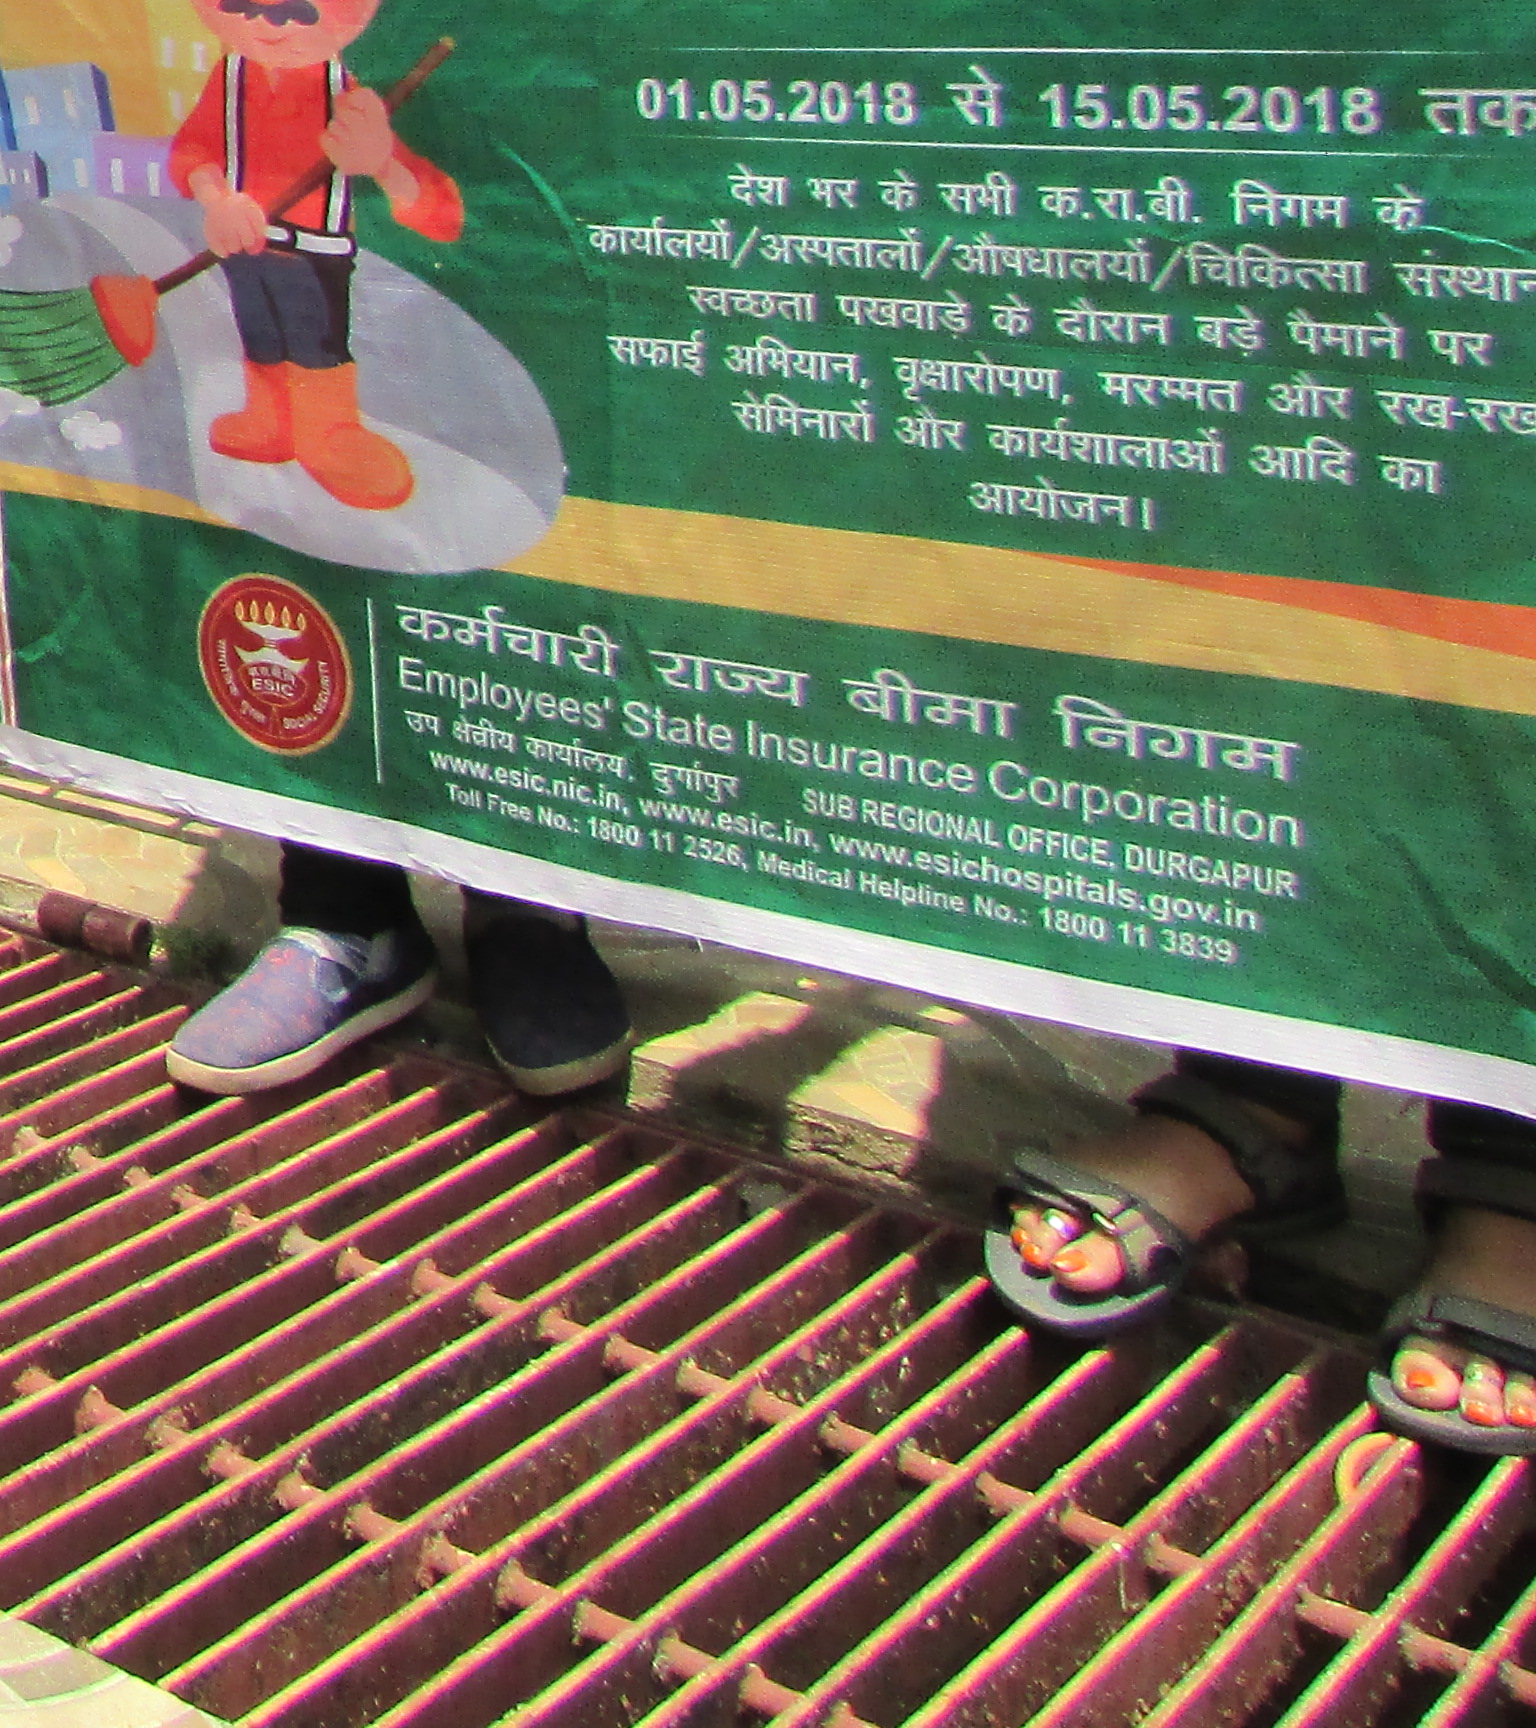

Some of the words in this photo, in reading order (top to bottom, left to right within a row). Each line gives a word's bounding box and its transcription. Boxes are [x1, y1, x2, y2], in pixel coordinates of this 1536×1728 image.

[636, 76, 920, 127] 01.05.2018
[946, 65, 1002, 129] से
[1037, 82, 1383, 137] 15.05.2018
[1418, 88, 1536, 136] तक
[728, 162, 790, 207] देश
[806, 176, 860, 209] भर
[877, 168, 920, 212] के
[936, 171, 1017, 217] सभी
[1038, 175, 1205, 223] क.रा.बी.
[1230, 178, 1350, 229] निगम
[1372, 183, 1427, 232] के
[686, 285, 818, 323] स्वच्छता
[835, 289, 972, 338] पखवाड़े
[990, 293, 1032, 337] के
[1053, 297, 1173, 345] दौरान
[1192, 305, 1264, 358] बड़े
[1285, 308, 1405, 360] पैमाने
[1426, 329, 1494, 366] पर
[606, 329, 706, 377] सफाई
[1097, 372, 1245, 414] मरम्मत
[1265, 372, 1353, 419] और
[1373, 389, 1536, 436] रख-रख
[730, 390, 877, 443] सेमिनारों
[892, 404, 966, 451] और
[985, 417, 1225, 473] कार्यशालाओं
[1247, 434, 1356, 485] आदि
[1376, 454, 1443, 494] का
[251, 677, 296, 698] ESIC
[312, 659, 332, 715] SECURITY
[394, 603, 623, 677] कर्मचारी
[647, 649, 811, 708] राज्य
[841, 668, 1020, 739] बीमा
[1051, 694, 1302, 782] निगम
[397, 654, 616, 731] Employees'
[622, 699, 737, 755] State
[745, 719, 977, 795] Insurance
[986, 758, 1305, 849] Corporation
[403, 709, 442, 737] उप
[451, 714, 518, 755] क्षेत्रीय
[648, 760, 740, 803] दुर्गापुर
[429, 750, 630, 816] www.esic.nic.in,
[638, 796, 821, 854] www.esic.in,
[828, 830, 1263, 933] www.esichospitals.gov.in
[445, 782, 483, 811] Toll
[487, 794, 534, 823] Free
[537, 804, 581, 835] No.:
[586, 816, 643, 849] 1800
[649, 829, 678, 854] 11
[683, 835, 750, 873] 2526,
[756, 848, 855, 891] Medical
[858, 872, 967, 916] Helpline
[1038, 905, 1114, 943] 1800
[1117, 921, 1152, 950] 11
[1159, 926, 1238, 965] 3839
[801, 787, 858, 822] SUB
[861, 798, 1004, 849] REGIONAL
[1124, 842, 1302, 900] DURGAPUR
